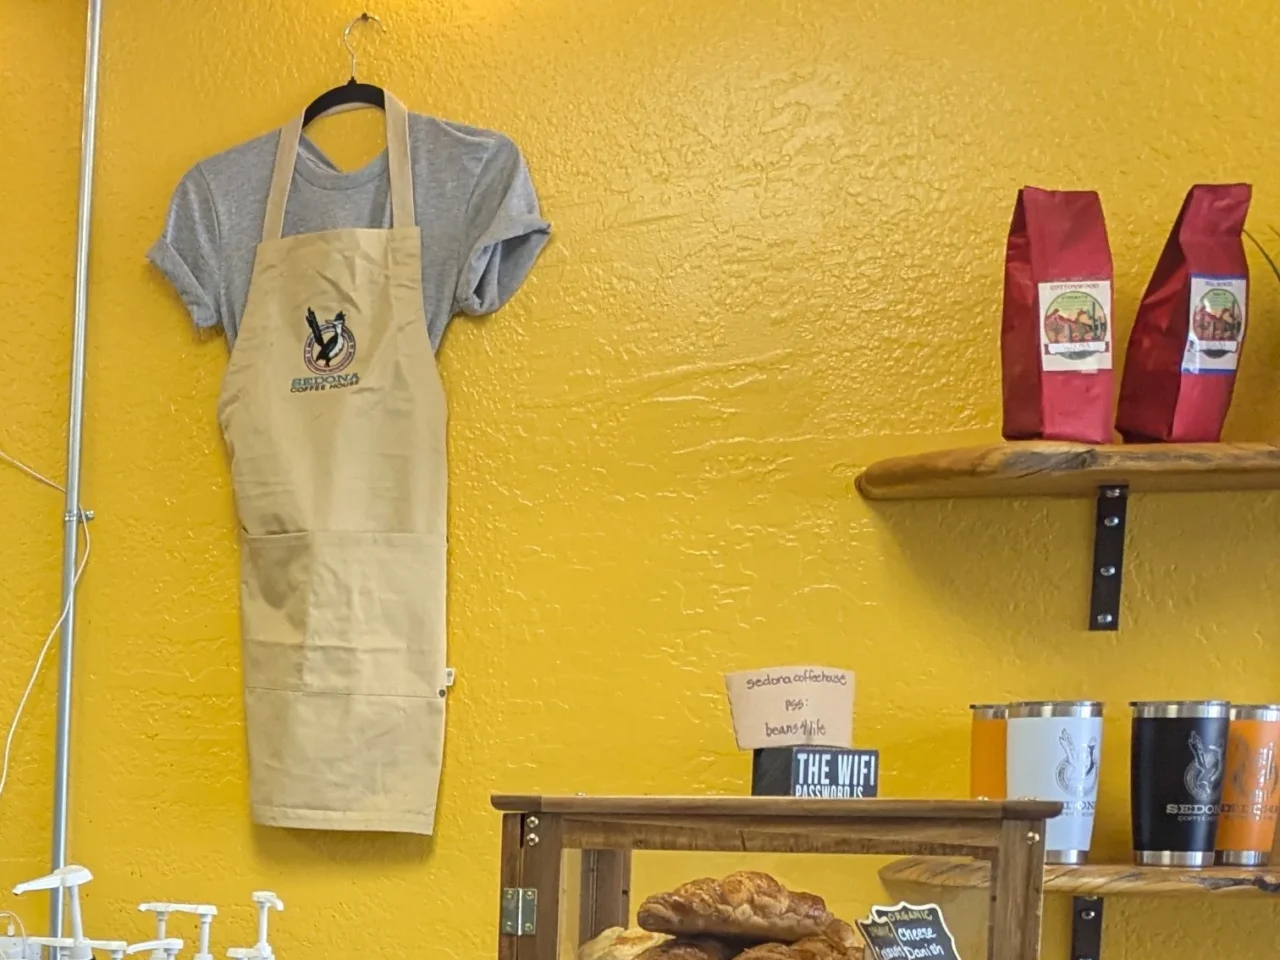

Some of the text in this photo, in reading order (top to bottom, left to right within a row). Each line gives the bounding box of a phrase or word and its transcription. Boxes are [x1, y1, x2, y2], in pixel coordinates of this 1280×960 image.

[290, 380, 360, 393] COFFEE HOUSE
[291, 373, 360, 388] SEDONA
[797, 753, 876, 786] THE WIFI
[795, 784, 851, 799] PASSWORD
[887, 909, 933, 922] ORGANIC
[897, 926, 937, 942] Cheese
[904, 943, 945, 960] Danish
